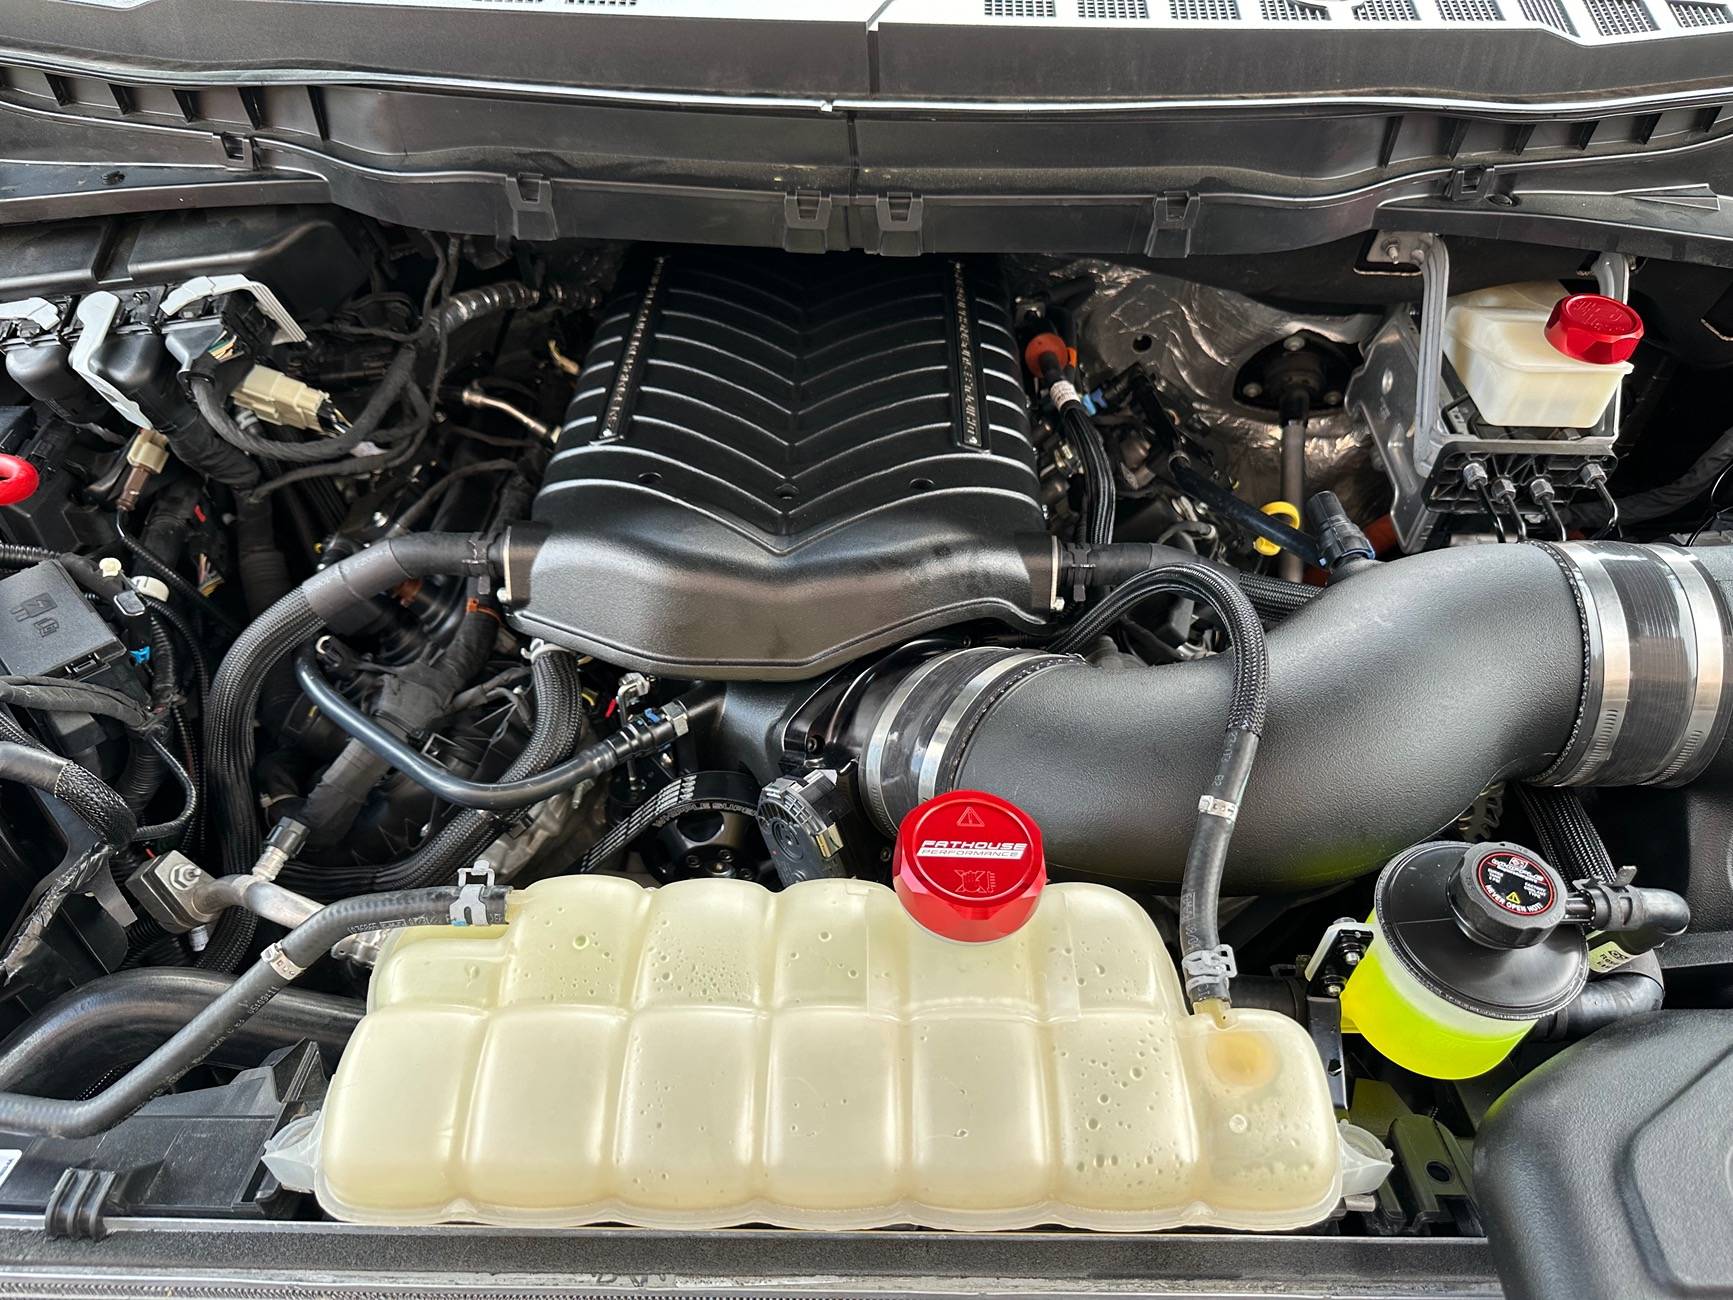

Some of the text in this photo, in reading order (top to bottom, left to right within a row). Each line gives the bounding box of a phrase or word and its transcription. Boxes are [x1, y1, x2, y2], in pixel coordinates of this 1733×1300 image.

[653, 802, 711, 827] WHIPPLE
[921, 840, 1028, 850] FATHOUSE
[921, 849, 1019, 857] PERFORMANCE
[1485, 884, 1506, 905] NEVER
[1506, 901, 1527, 912] OPEN
